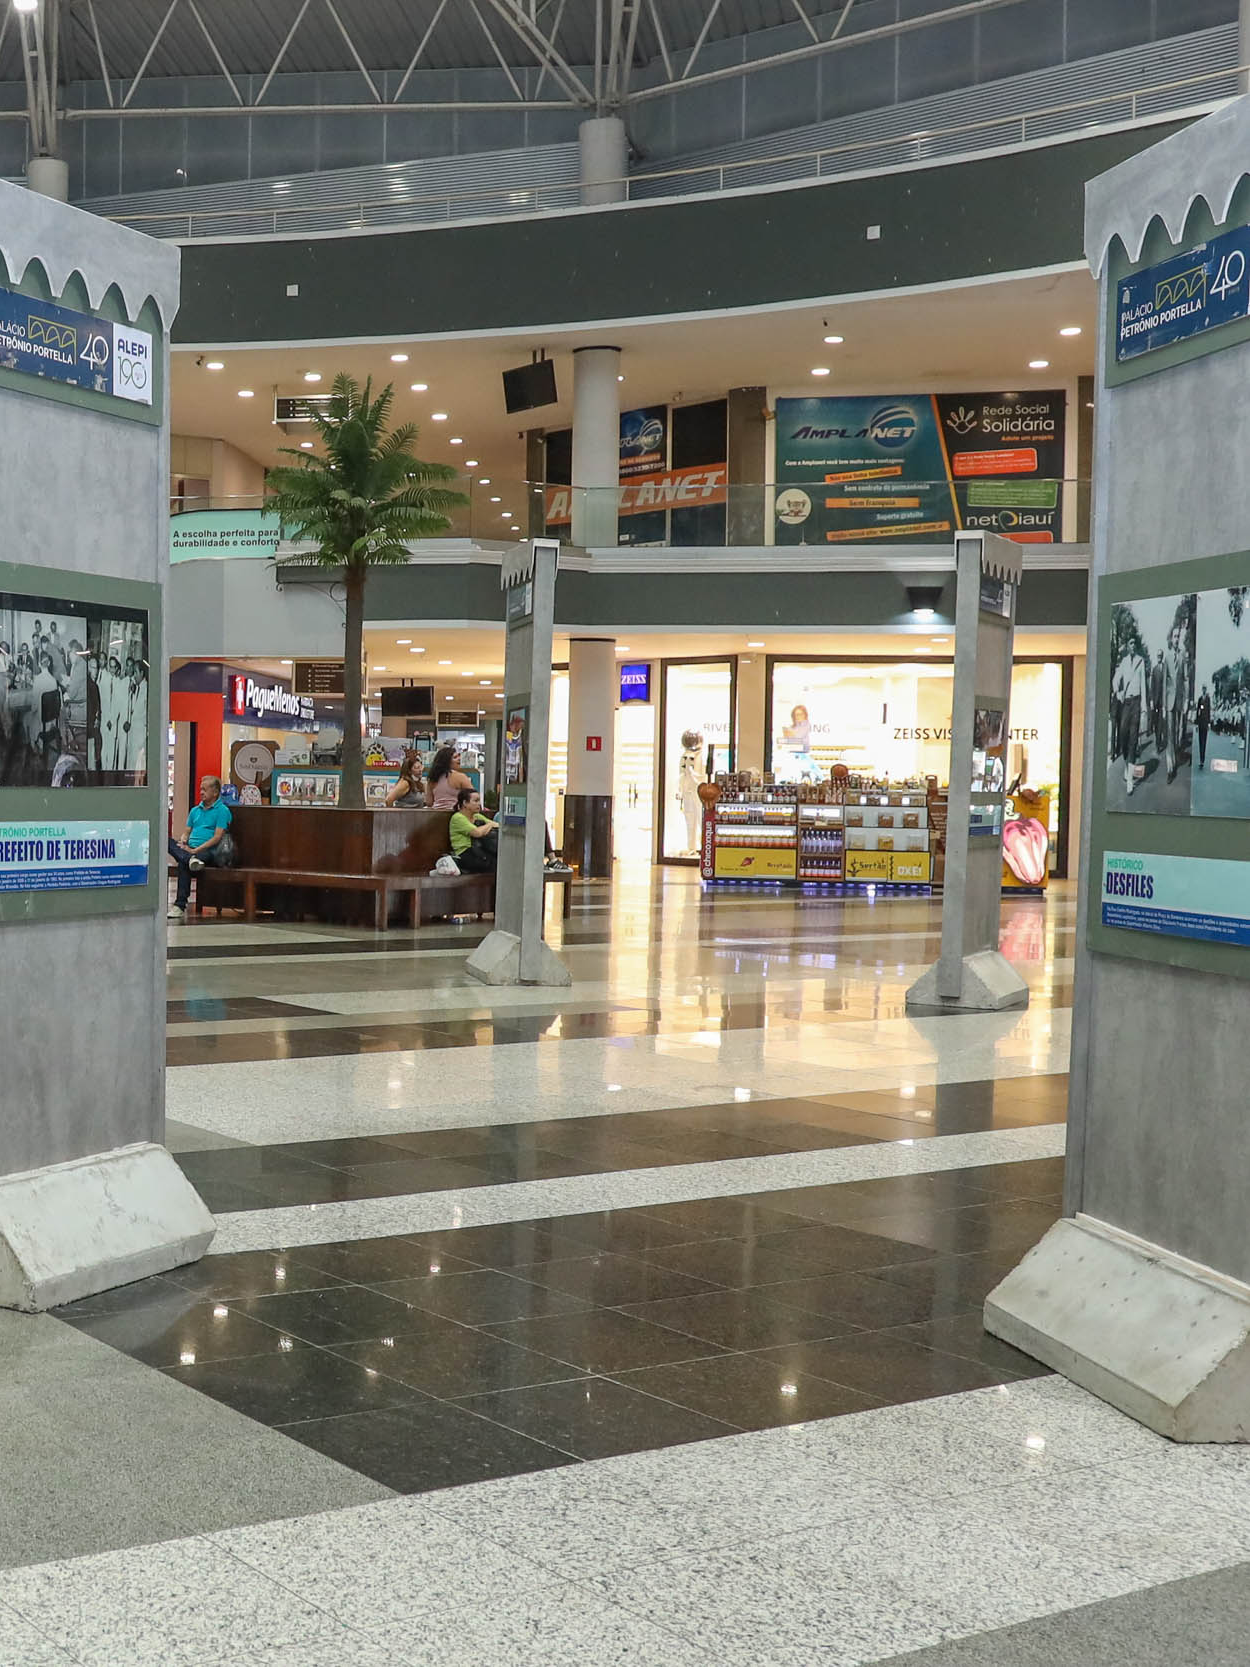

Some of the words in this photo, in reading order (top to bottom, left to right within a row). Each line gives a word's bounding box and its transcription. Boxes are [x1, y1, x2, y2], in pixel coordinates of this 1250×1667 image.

[1209, 249, 1245, 301] 40
[1120, 313, 1158, 340] PETRÔNIO
[1159, 298, 1202, 325] PORTELLA
[1121, 301, 1154, 323] PALÁCIO
[33, 345, 74, 366] PORTELLA
[79, 333, 109, 370] 40
[117, 338, 148, 359] ALEPI
[982, 405, 1013, 416] Rede
[1015, 404, 1050, 415] Social
[981, 416, 1055, 433] Solidária
[173, 530, 180, 538] A
[182, 529, 218, 539] escolha
[220, 528, 256, 540] perfeita
[258, 529, 279, 540] para
[173, 538, 230, 548] durabilidade
[240, 538, 280, 548] conforto
[621, 674, 647, 685] ZEISS
[894, 727, 930, 740] ZEISS
[1008, 728, 1039, 741] NTER
[28, 827, 66, 838] PORTELLA
[46, 840, 61, 861] DE
[64, 839, 116, 860] TERESINA
[703, 821, 714, 877] @chicoxique
[1107, 858, 1143, 870] HISTÓRICO
[1106, 871, 1154, 899] DESFILES
